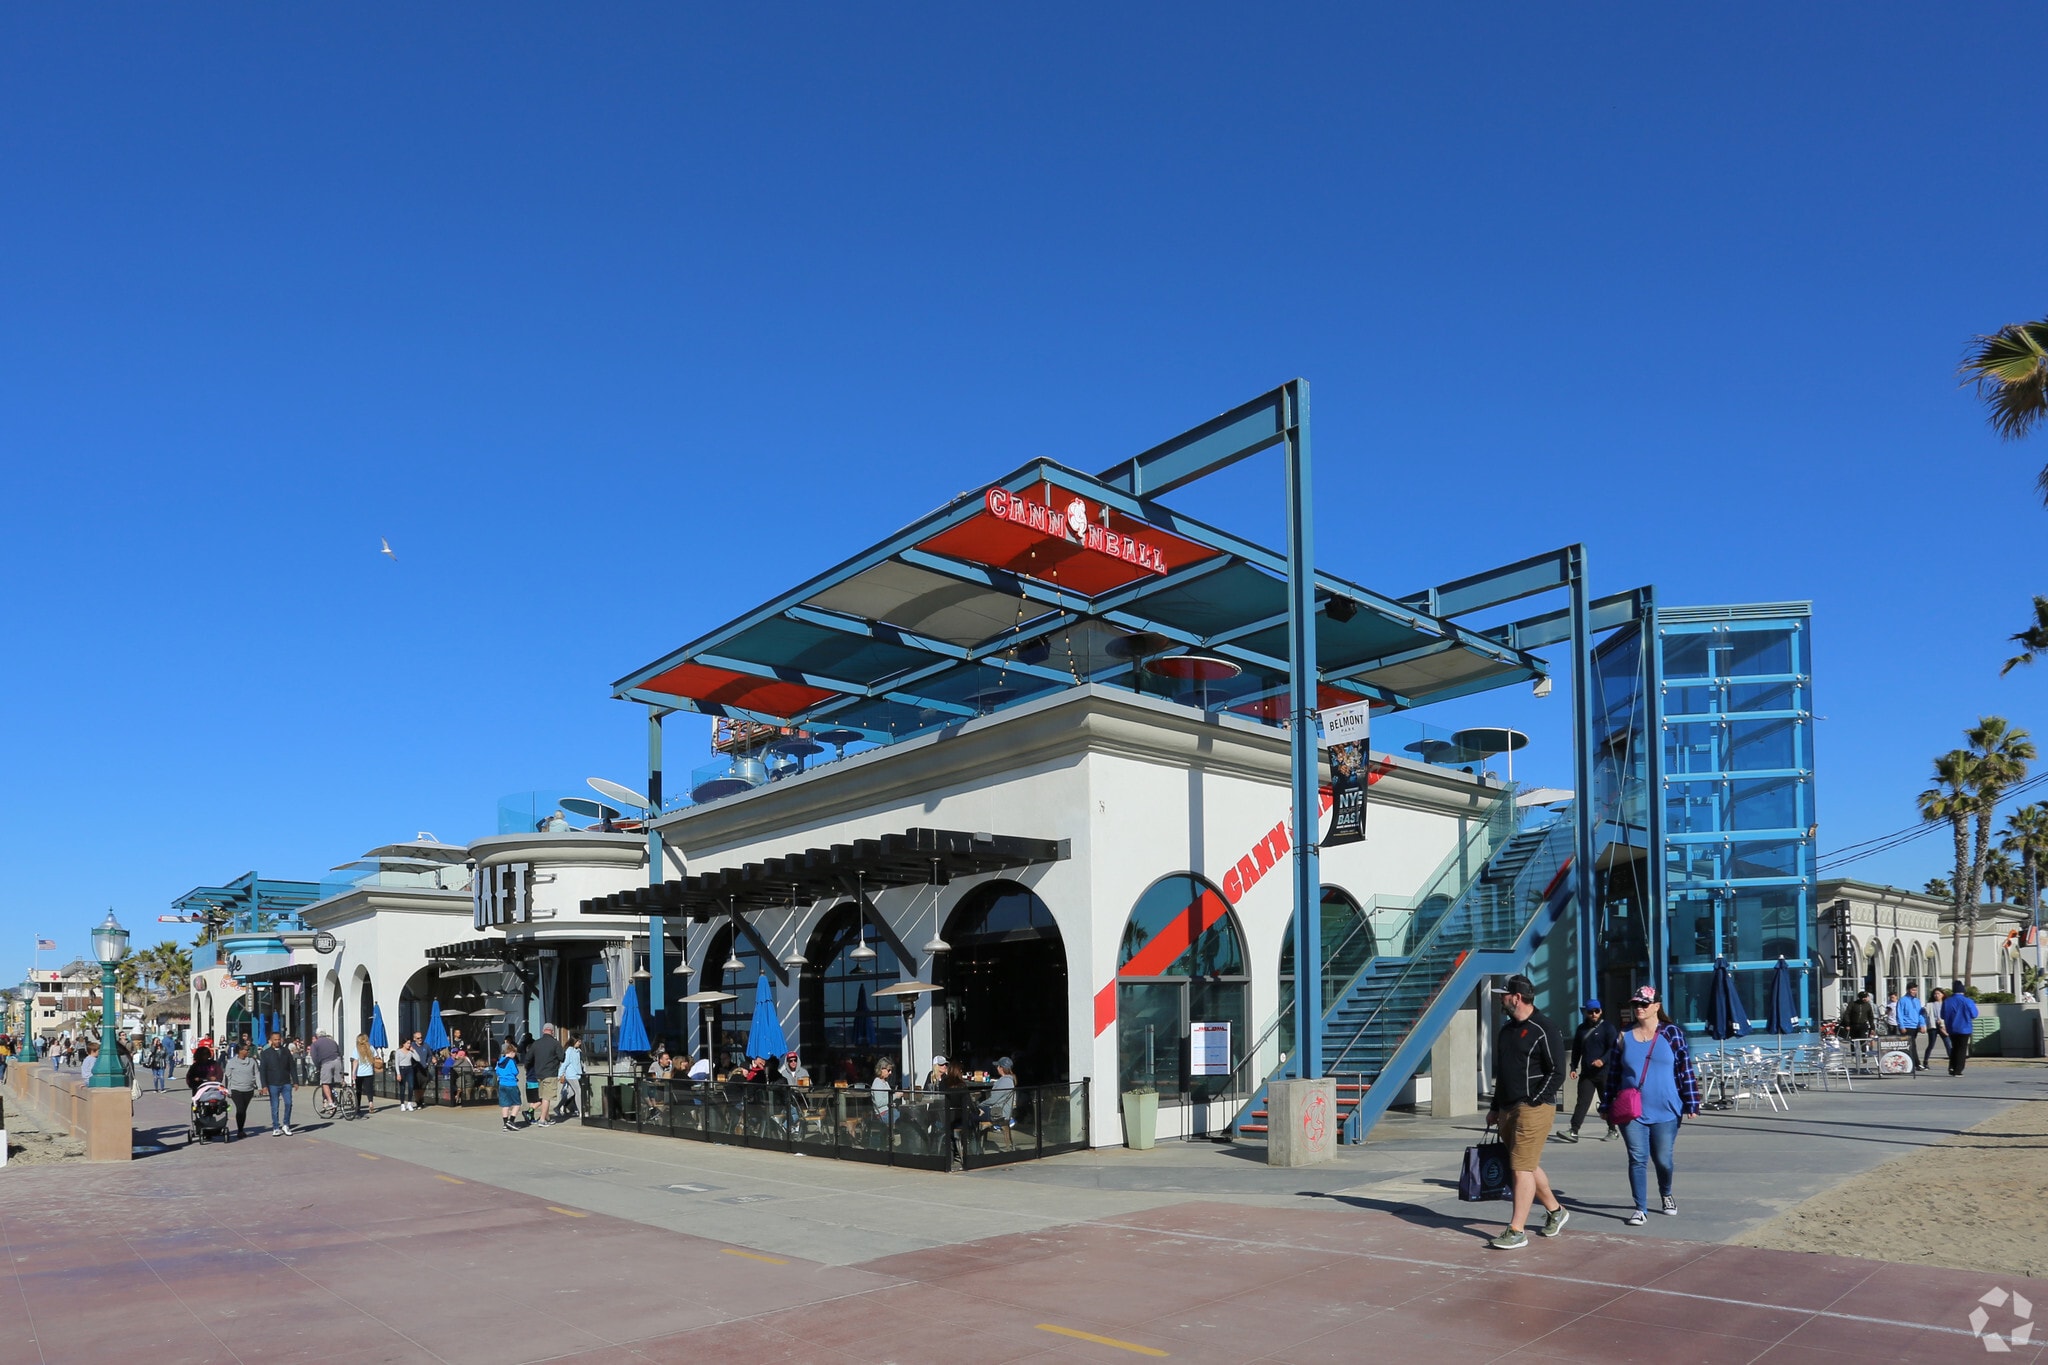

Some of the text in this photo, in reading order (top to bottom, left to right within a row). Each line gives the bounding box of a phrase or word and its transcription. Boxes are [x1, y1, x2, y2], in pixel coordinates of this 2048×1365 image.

[1329, 714, 1364, 731] BELMONT
[1339, 790, 1364, 808] NYE
[1836, 909, 1844, 965] RENTALS
[1844, 909, 1852, 965] RENTALS
[1880, 1040, 1908, 1048] BREAKFAST
